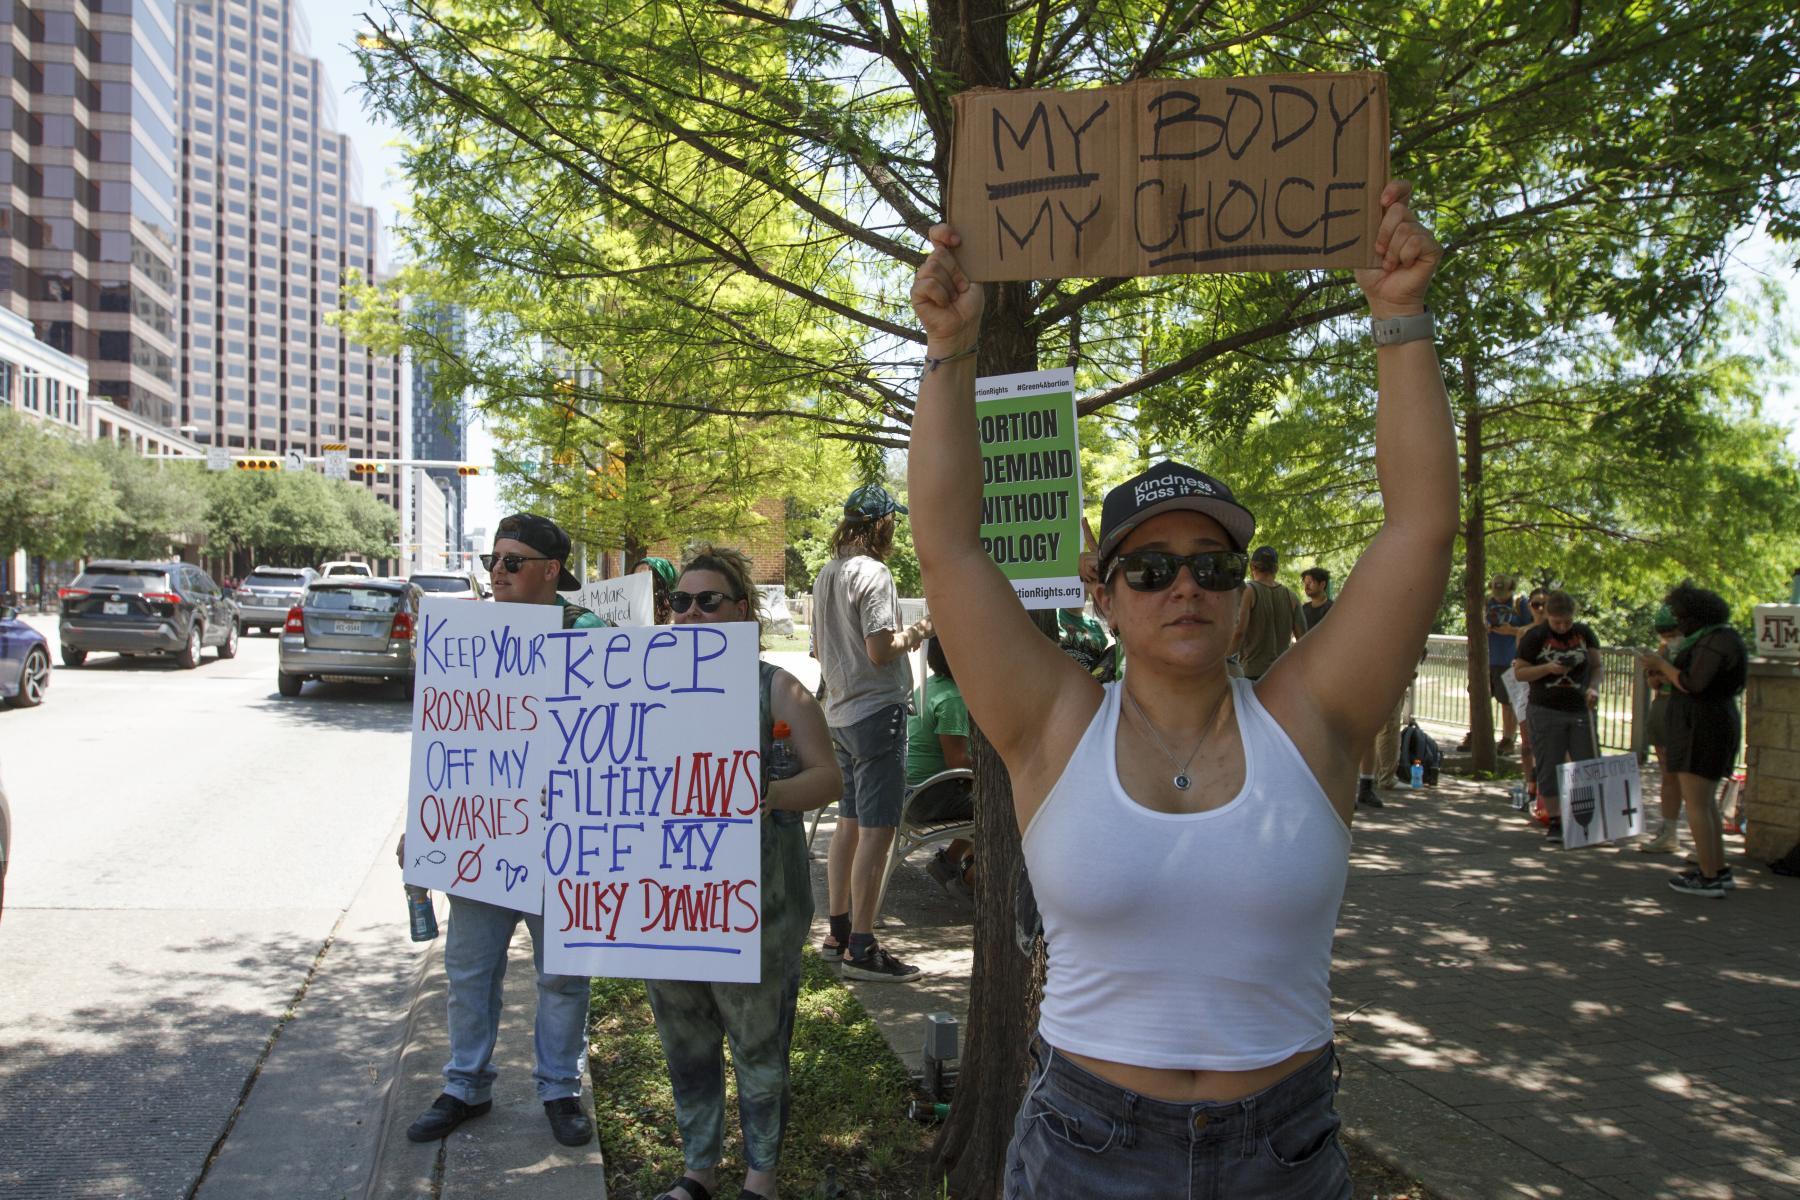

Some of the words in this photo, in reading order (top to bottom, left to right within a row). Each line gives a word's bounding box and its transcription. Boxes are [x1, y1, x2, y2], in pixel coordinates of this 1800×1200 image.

[991, 100, 1110, 175] MY
[1140, 82, 1377, 177] BODY
[995, 196, 1101, 262] MY
[1134, 176, 1367, 256] CHOICE
[975, 386, 1009, 397] rtionRights
[1016, 378, 1070, 392] #Green4Abortion
[977, 409, 1059, 444] ORTION
[1180, 484, 1190, 495] it
[423, 614, 486, 679] KEEP
[491, 625, 546, 679] YOUR
[421, 686, 539, 732] ROSARIES
[426, 741, 478, 793] OFF
[490, 741, 529, 789] MY
[671, 750, 760, 817] LAWS
[420, 794, 529, 842] OVARIES
[545, 822, 644, 876] OFF
[660, 823, 729, 872] MY
[558, 878, 629, 941] SILKY
